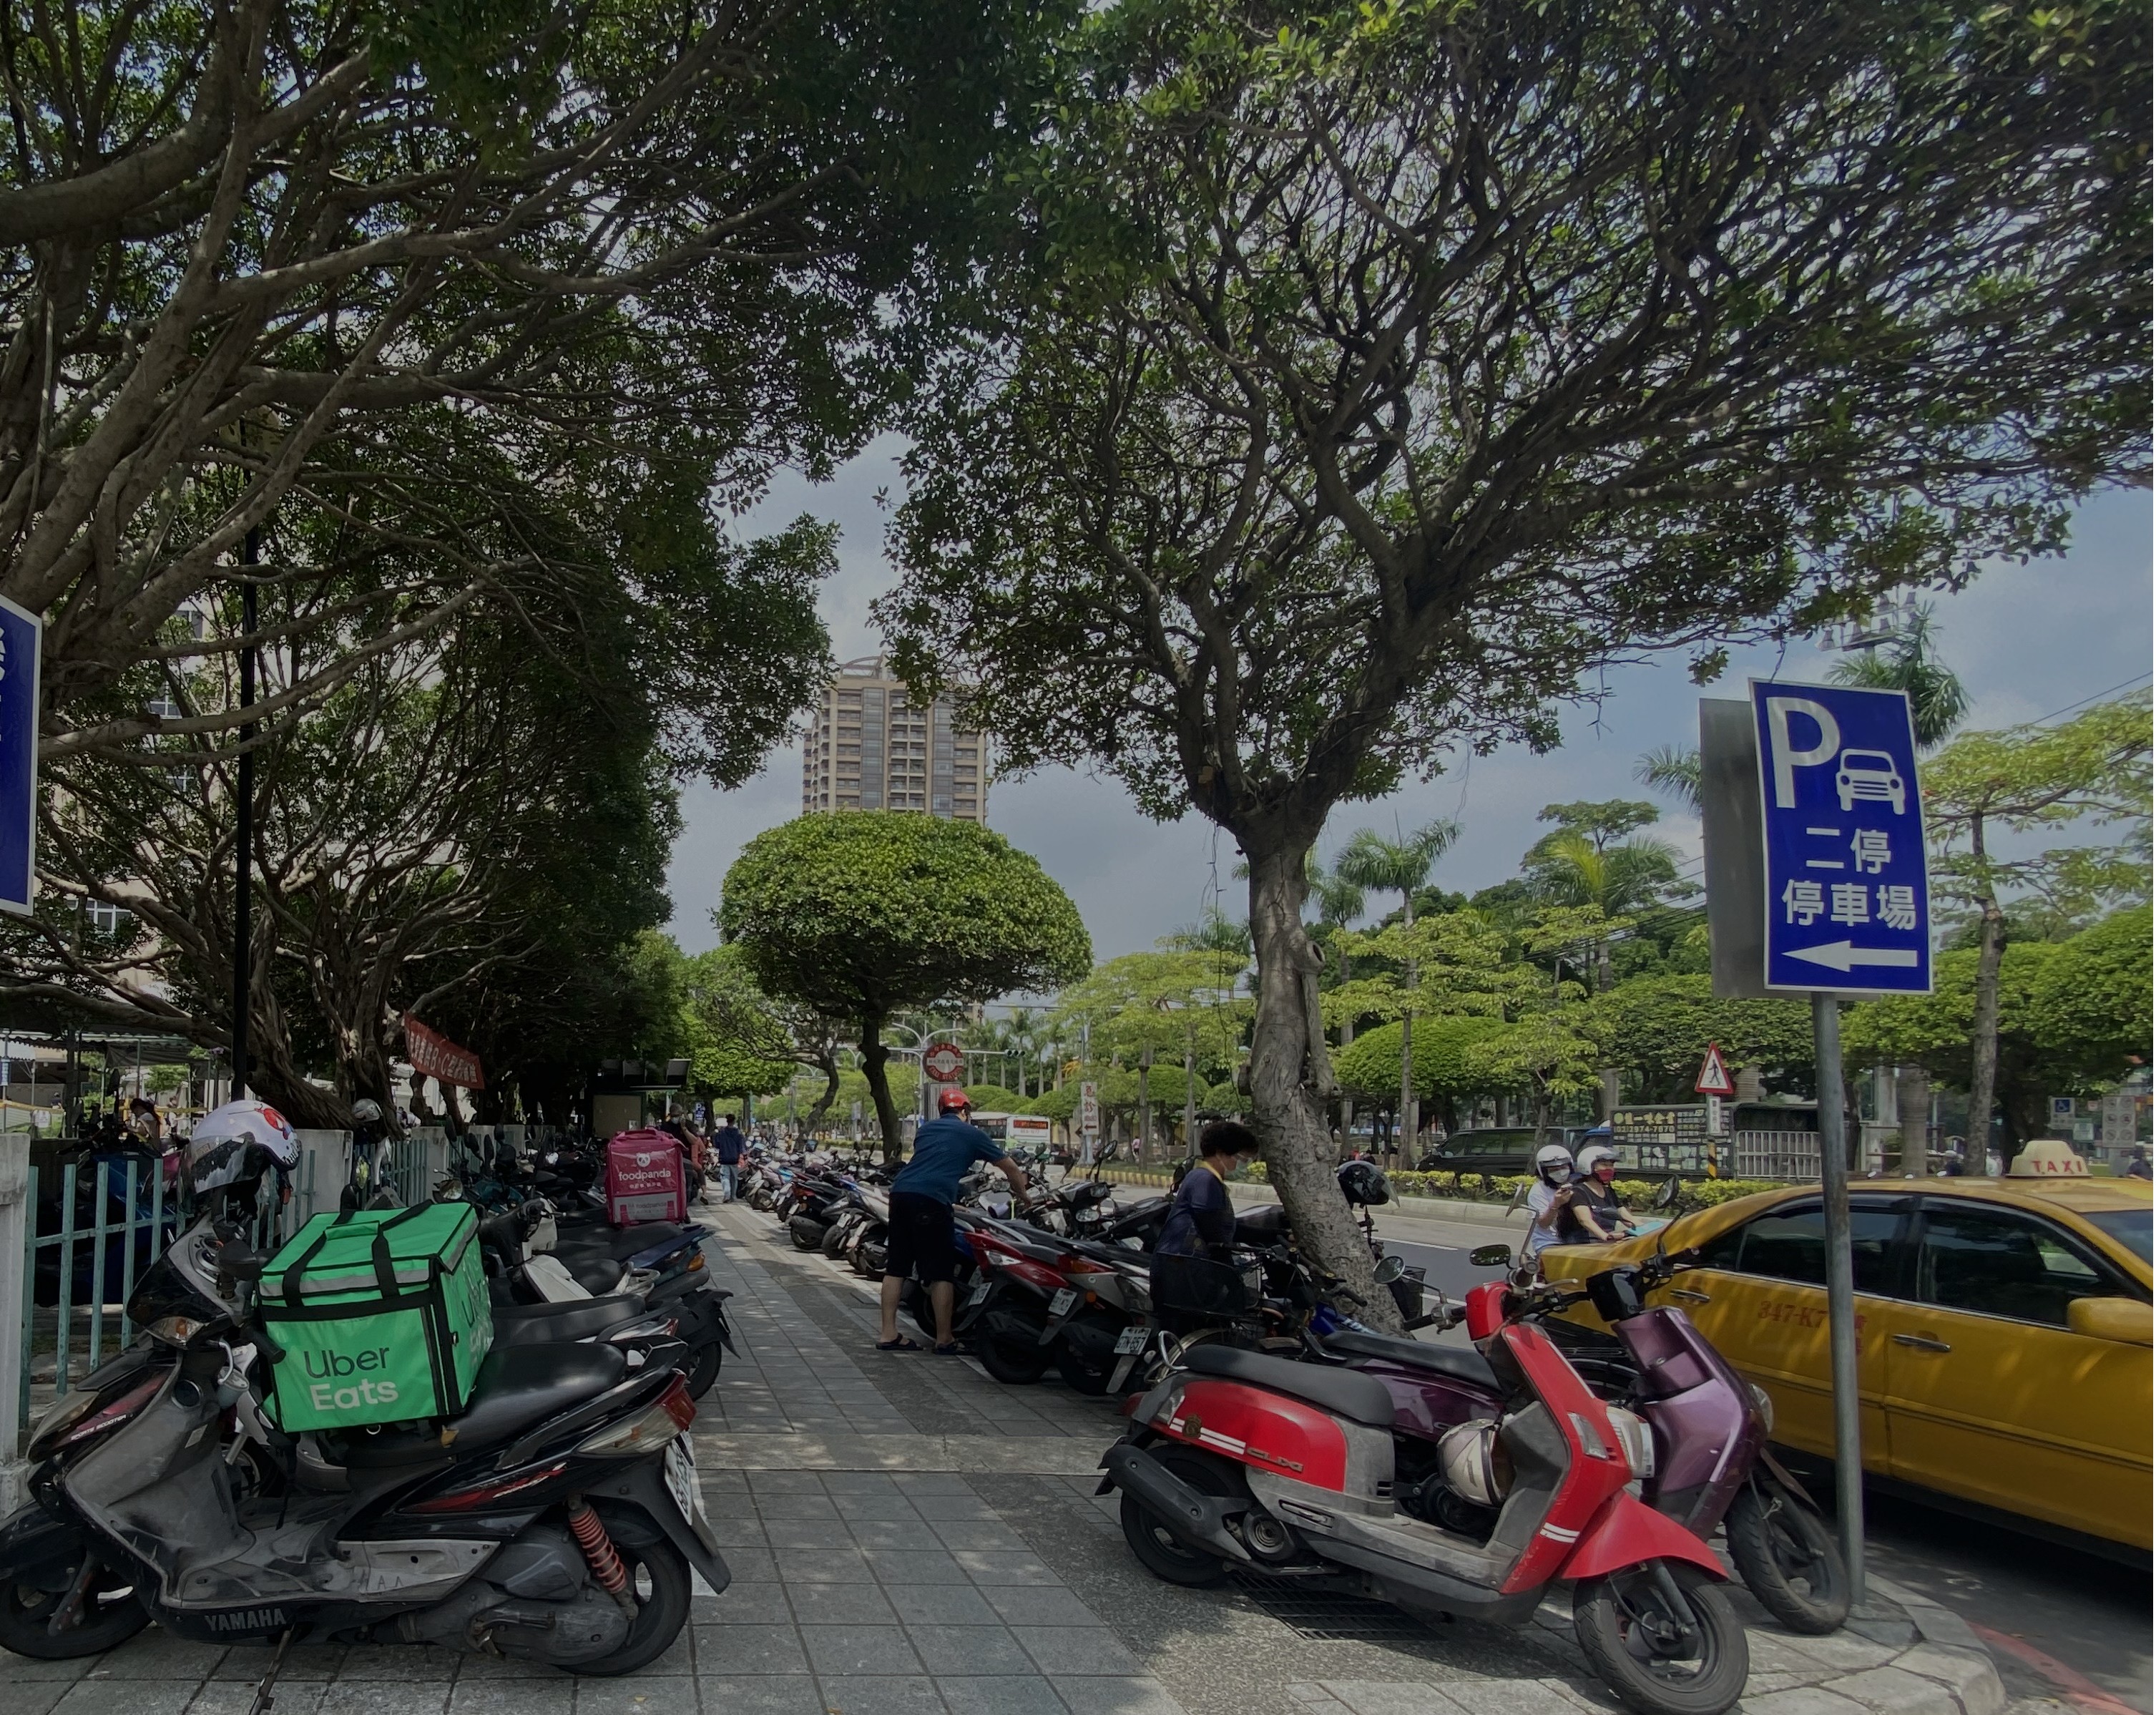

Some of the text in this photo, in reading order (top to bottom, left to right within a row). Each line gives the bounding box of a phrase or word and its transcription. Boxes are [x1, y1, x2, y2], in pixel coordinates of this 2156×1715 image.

[1766, 697, 1841, 808] P
[1806, 828, 1891, 874] 二停
[1781, 879, 1916, 931] 停車場
[618, 1168, 671, 1181] foodpanda
[2032, 1161, 2082, 1173] TAXI
[303, 1347, 390, 1379] Uber
[310, 1378, 398, 1410] Eats
[205, 1608, 286, 1632] YAMAHA
